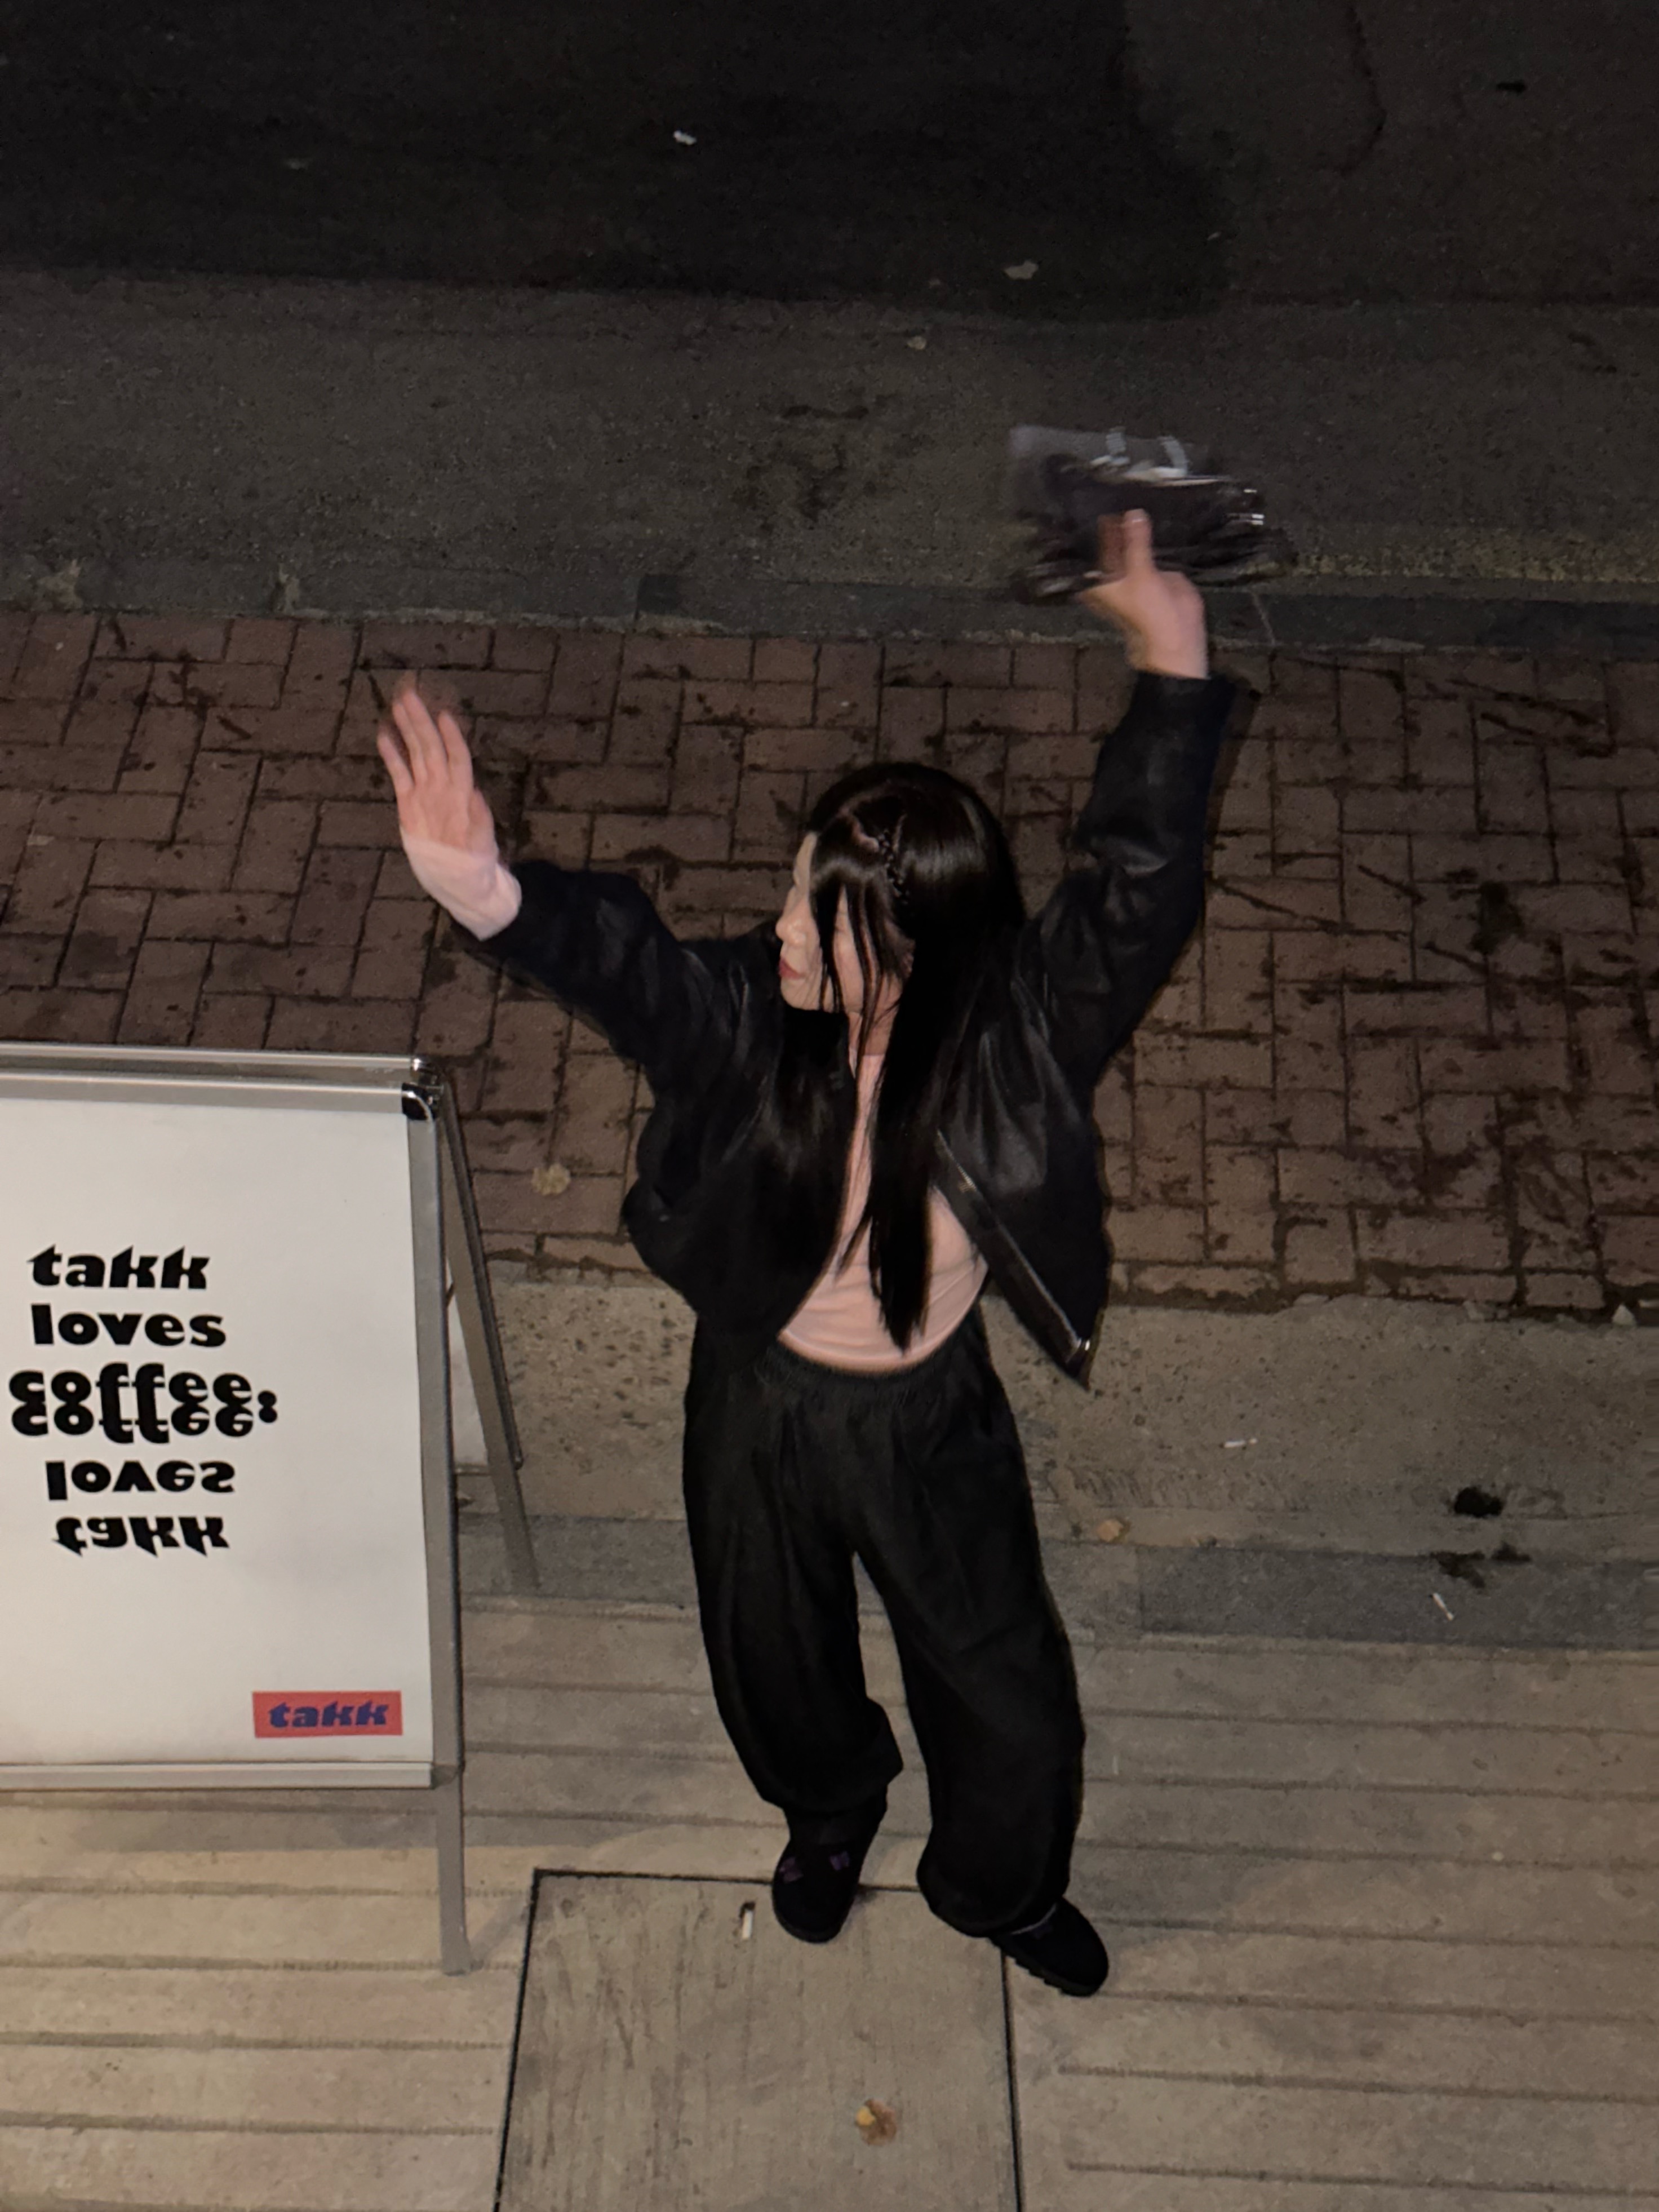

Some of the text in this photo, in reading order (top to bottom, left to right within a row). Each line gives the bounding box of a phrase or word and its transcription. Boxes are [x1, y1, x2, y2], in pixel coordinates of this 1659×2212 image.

[26, 1244, 210, 1289] takk
[30, 1303, 227, 1347] loves
[268, 1700, 389, 1728] takk
